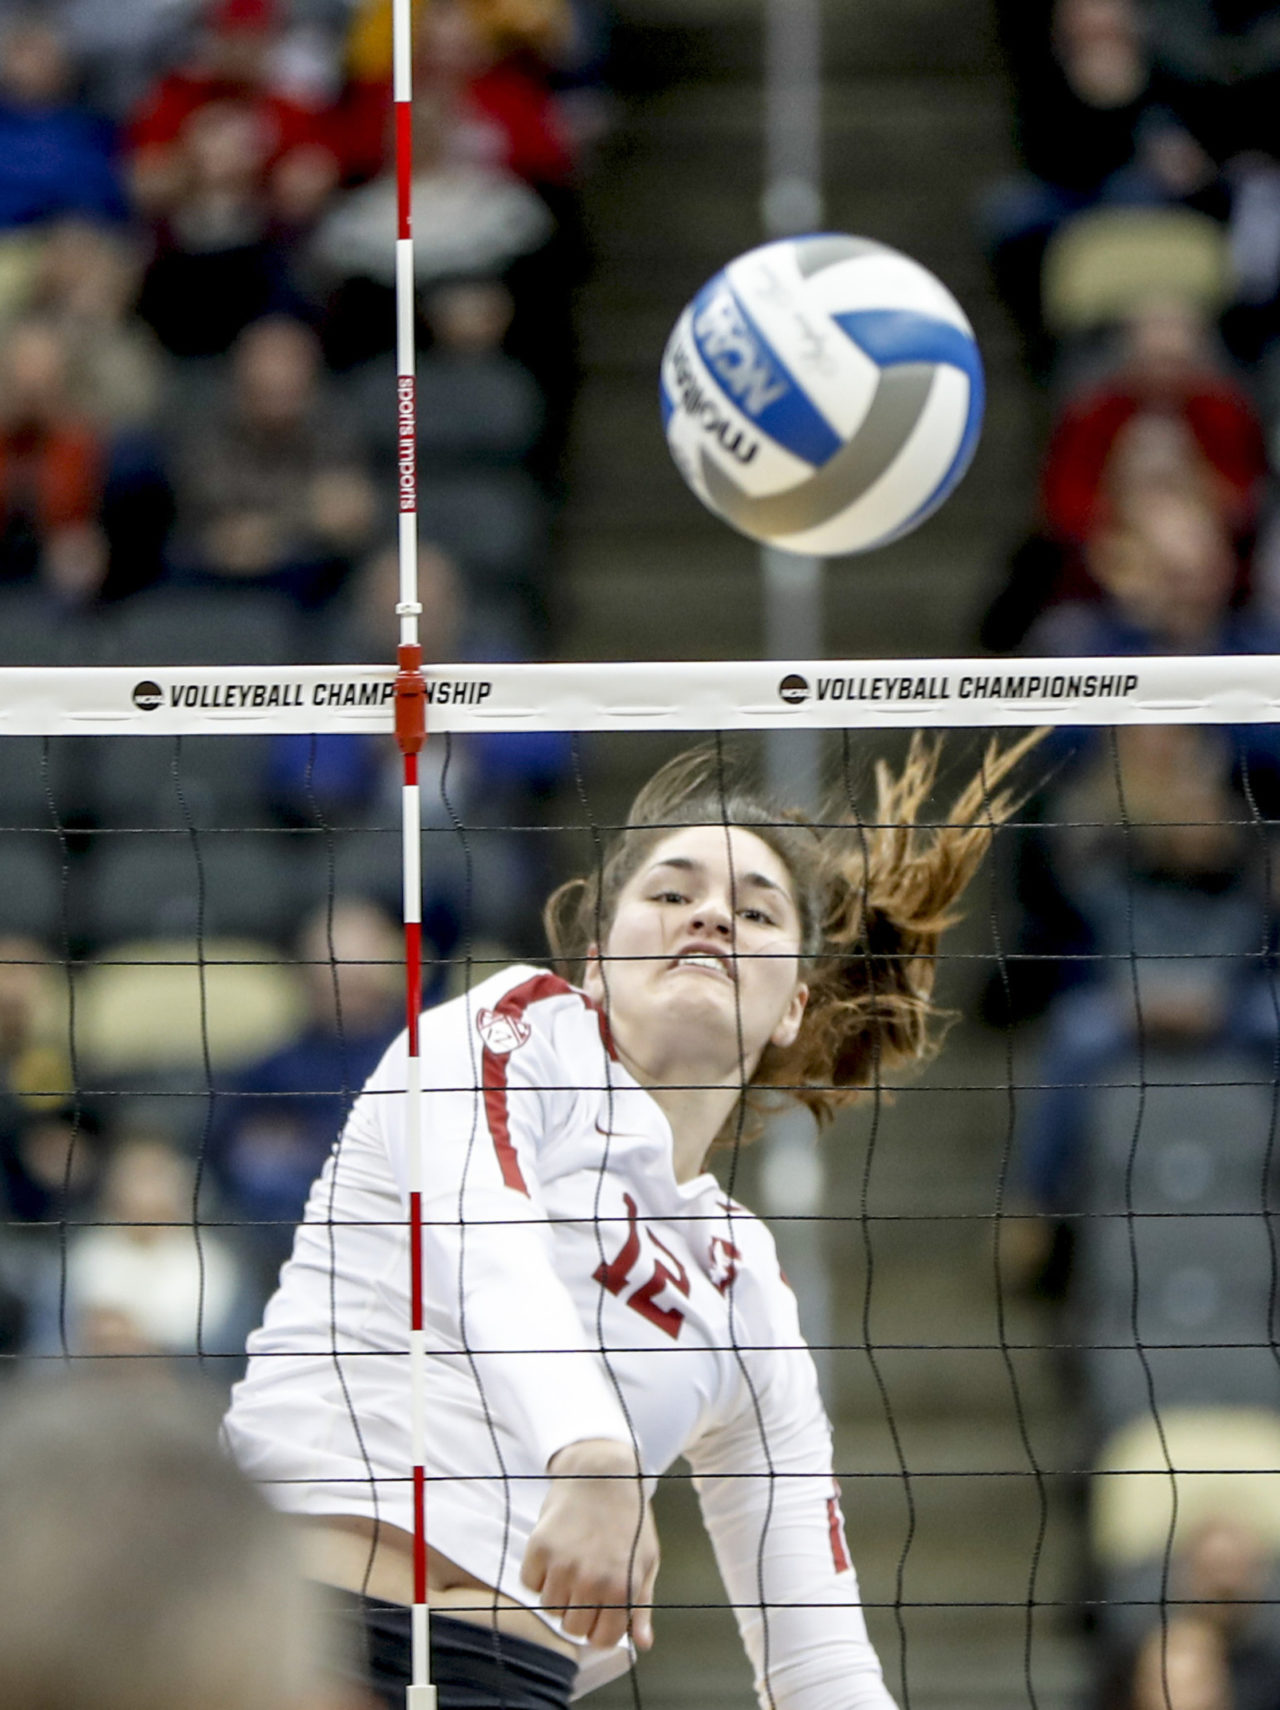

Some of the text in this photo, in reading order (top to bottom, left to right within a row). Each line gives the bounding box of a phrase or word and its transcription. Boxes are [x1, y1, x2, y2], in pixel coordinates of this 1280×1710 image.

[397, 377, 417, 510] sports imports
[171, 681, 493, 708] VOLLEYBALL CHAMPNSHIP
[816, 674, 1139, 701] VOLLEYBALL CHAMPIONSHIP
[591, 1191, 691, 1341] 12
